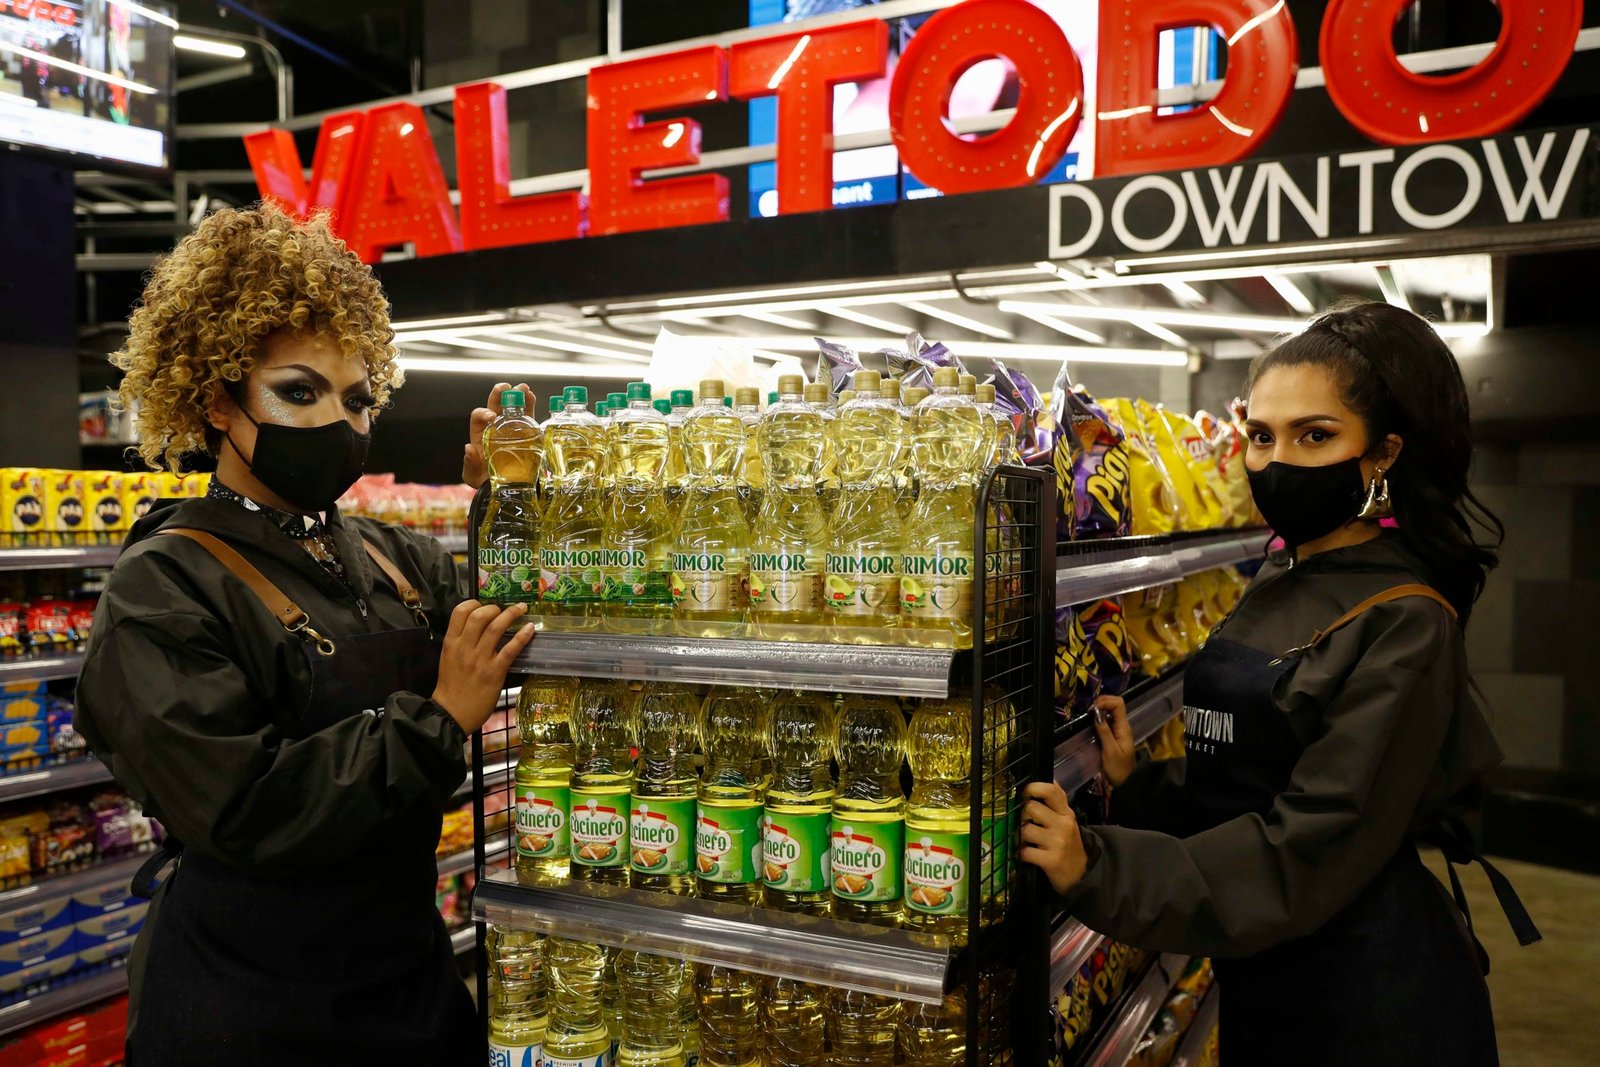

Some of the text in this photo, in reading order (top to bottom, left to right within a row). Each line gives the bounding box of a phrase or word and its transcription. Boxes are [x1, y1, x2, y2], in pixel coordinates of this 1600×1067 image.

[479, 548, 533, 566] RIMOR
[825, 552, 894, 574] PRIMOR
[570, 815, 623, 836] Cocinero
[631, 822, 675, 843] cinero
